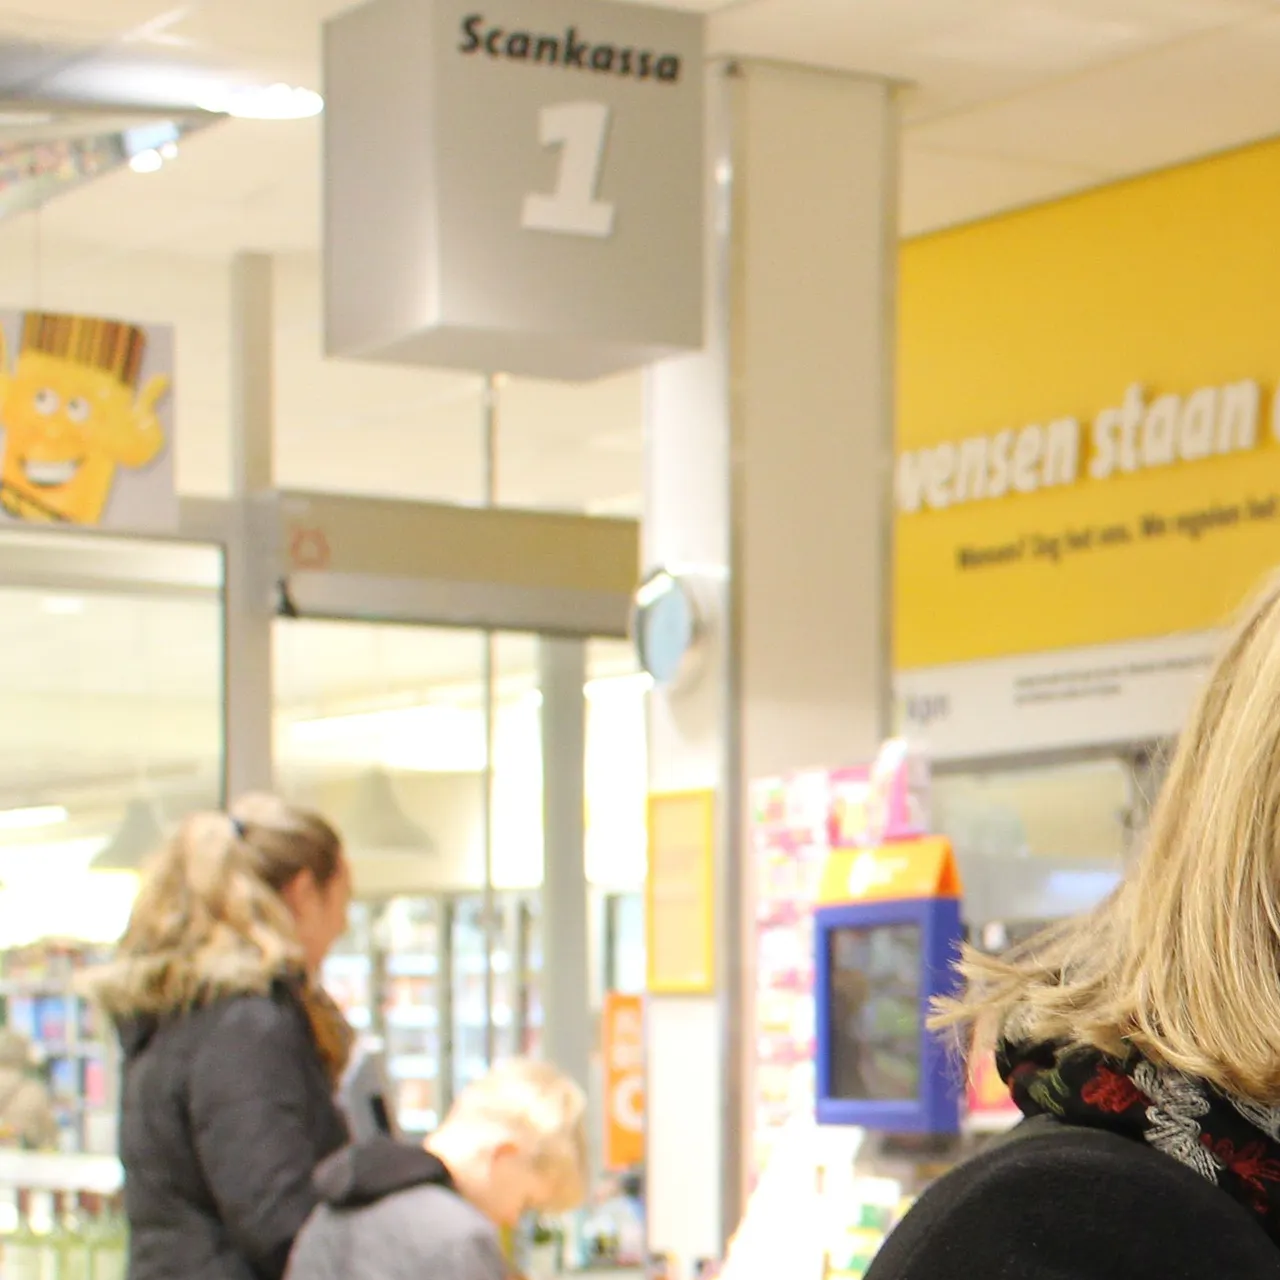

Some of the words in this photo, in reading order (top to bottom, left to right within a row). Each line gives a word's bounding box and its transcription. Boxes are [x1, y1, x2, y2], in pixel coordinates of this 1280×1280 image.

[458, 13, 681, 84] Scankassa
[520, 100, 614, 239] 1
[1089, 382, 1260, 479] staan
